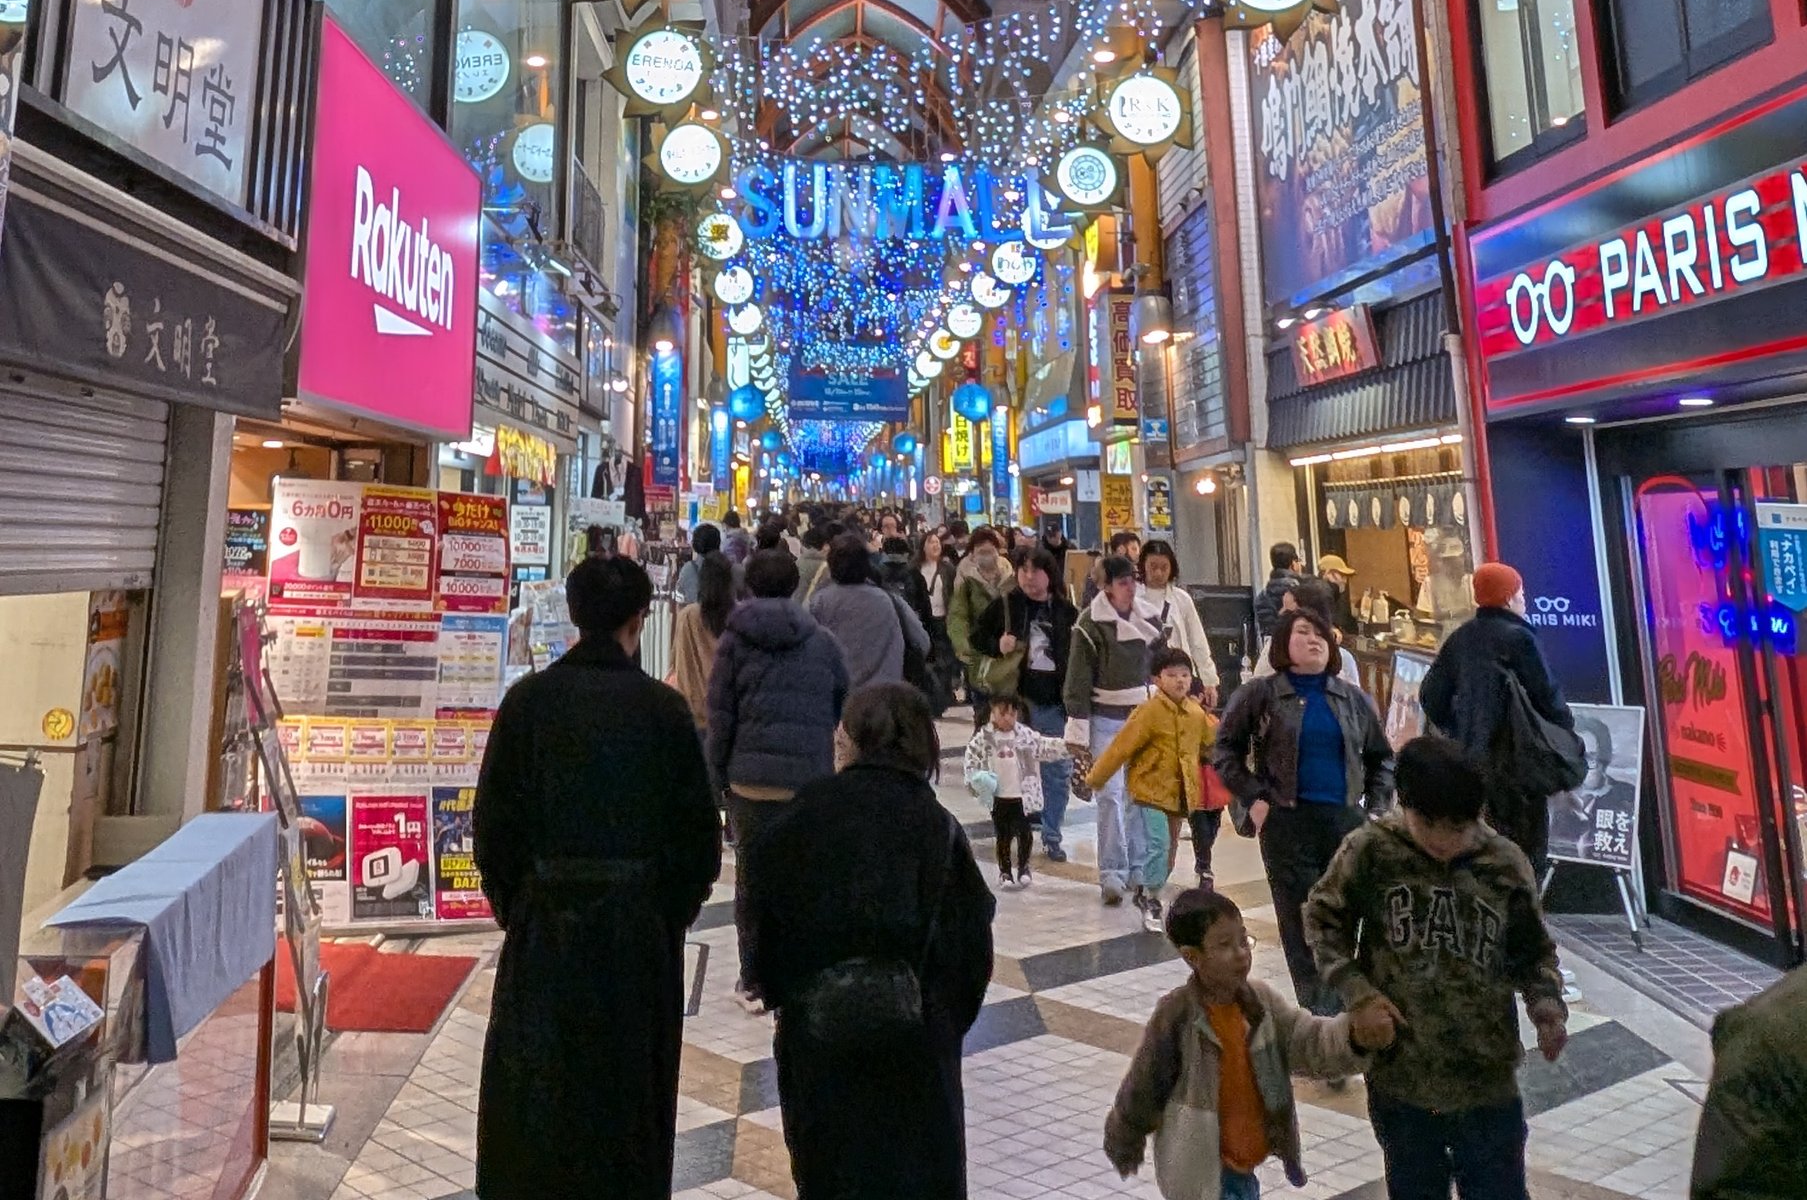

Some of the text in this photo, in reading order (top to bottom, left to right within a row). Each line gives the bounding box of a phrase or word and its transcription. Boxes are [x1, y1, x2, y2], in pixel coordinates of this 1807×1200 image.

[736, 163, 1073, 240] SUNMALL
[351, 165, 455, 330] Rakuten
[1598, 189, 1768, 318] PARIS
[145, 298, 219, 386] 文明堂
[1112, 301, 1138, 411] 高価買取
[955, 414, 969, 457] 日焼け
[1523, 613, 1597, 627] ARIS MIKI
[1594, 831, 1629, 855] 救え
[1595, 808, 1630, 832] 眼を
[453, 877, 481, 889] DAZ
[1385, 884, 1505, 969] GAP
